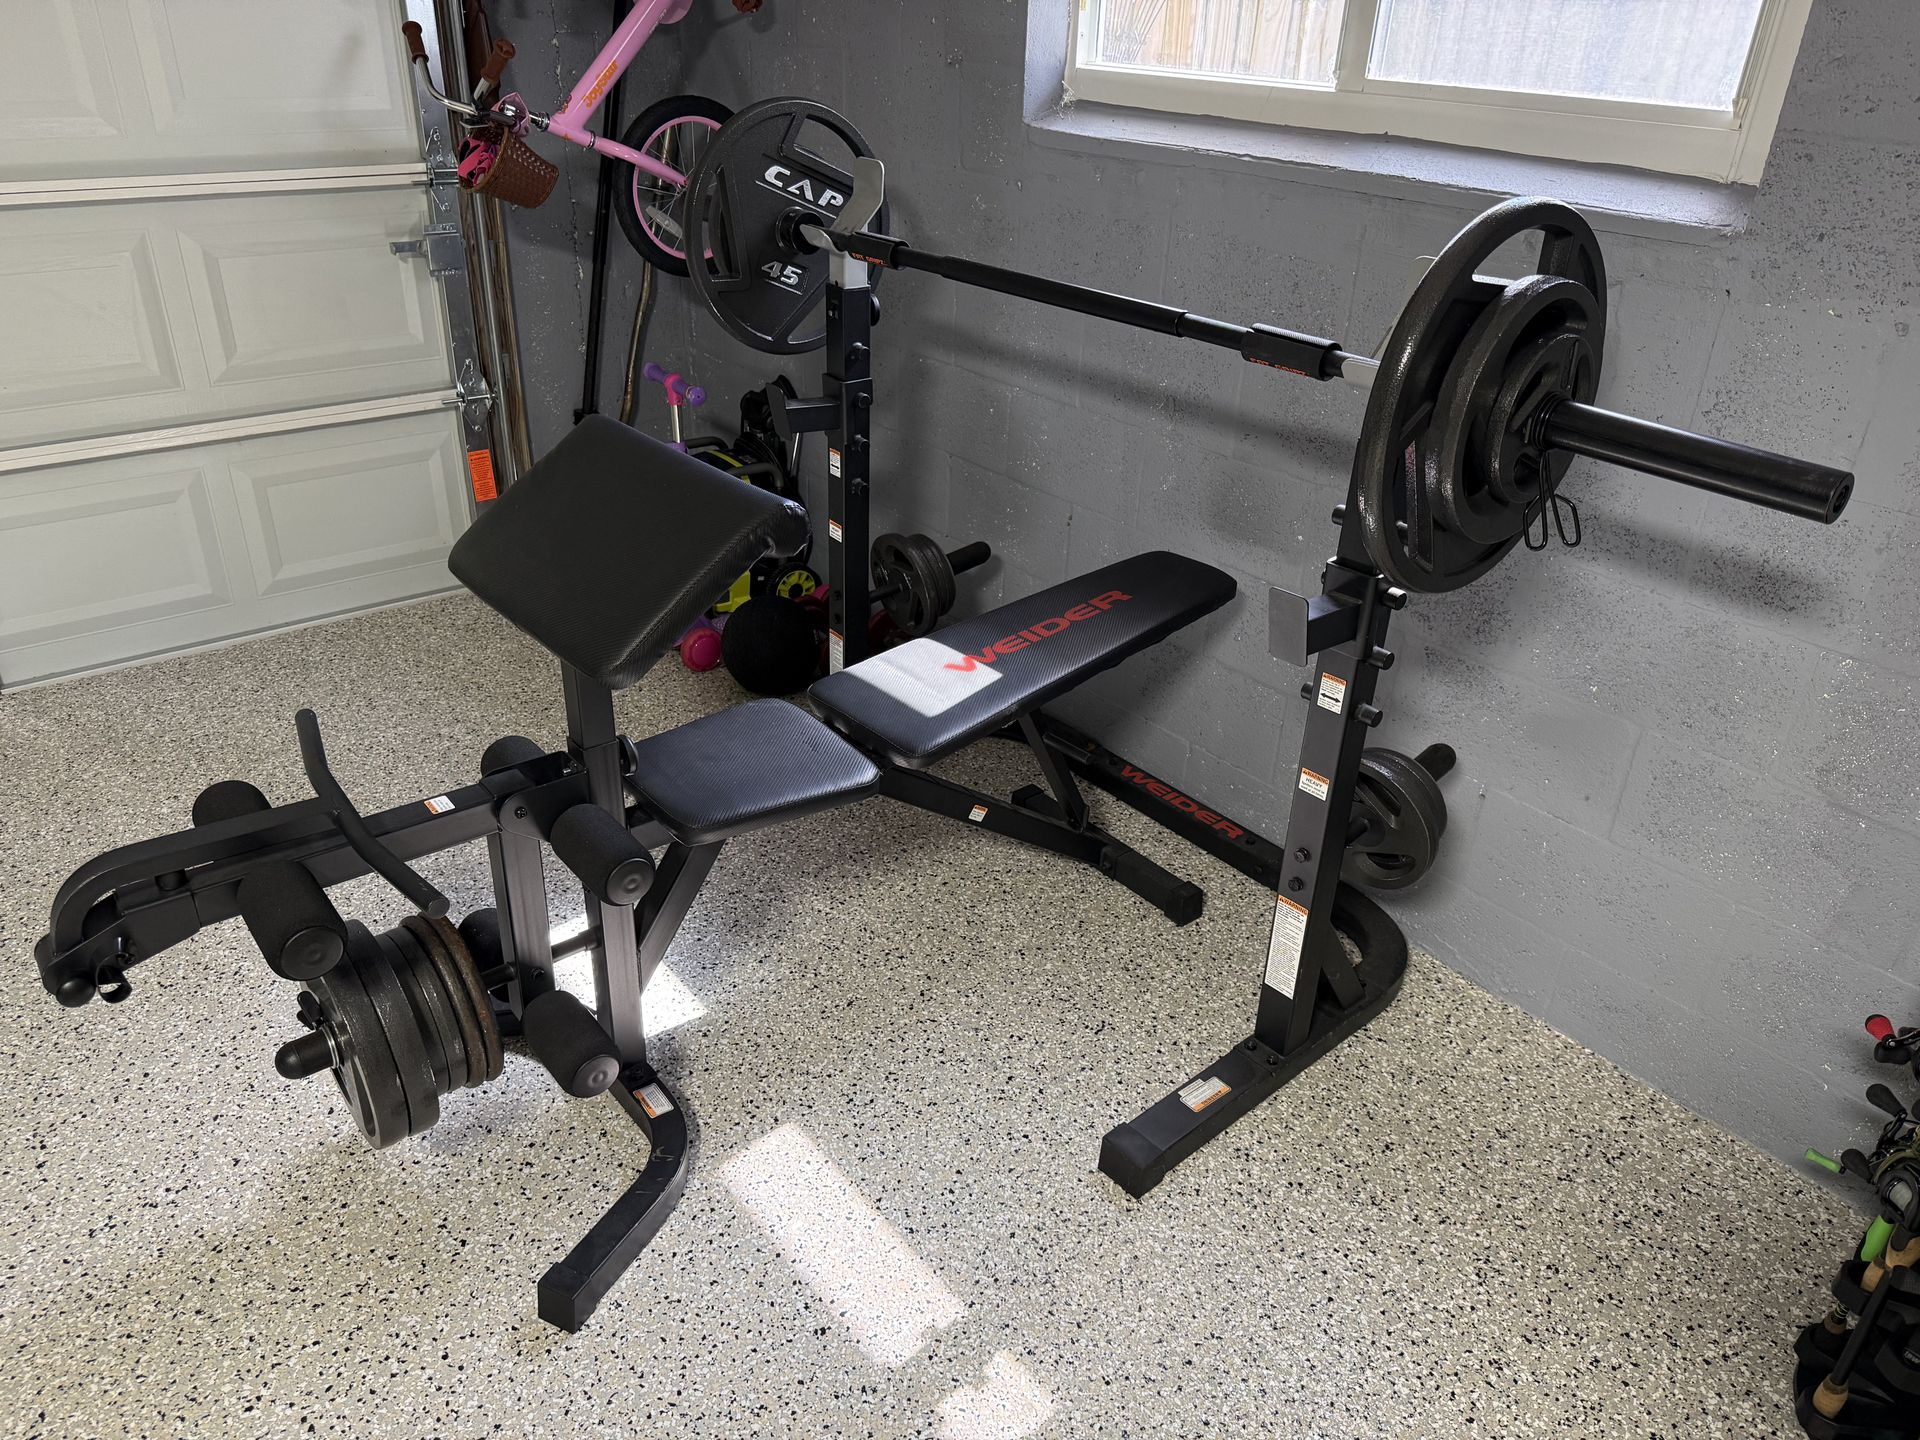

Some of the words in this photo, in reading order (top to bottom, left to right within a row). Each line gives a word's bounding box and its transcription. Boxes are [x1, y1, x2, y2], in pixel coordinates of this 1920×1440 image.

[764, 165, 845, 208] CAP
[761, 261, 803, 286] 45
[943, 590, 1133, 673] WEIDER
[1306, 771, 1329, 785] WARNING
[1121, 765, 1245, 839] WEIDER
[1284, 899, 1308, 916] WARNING
